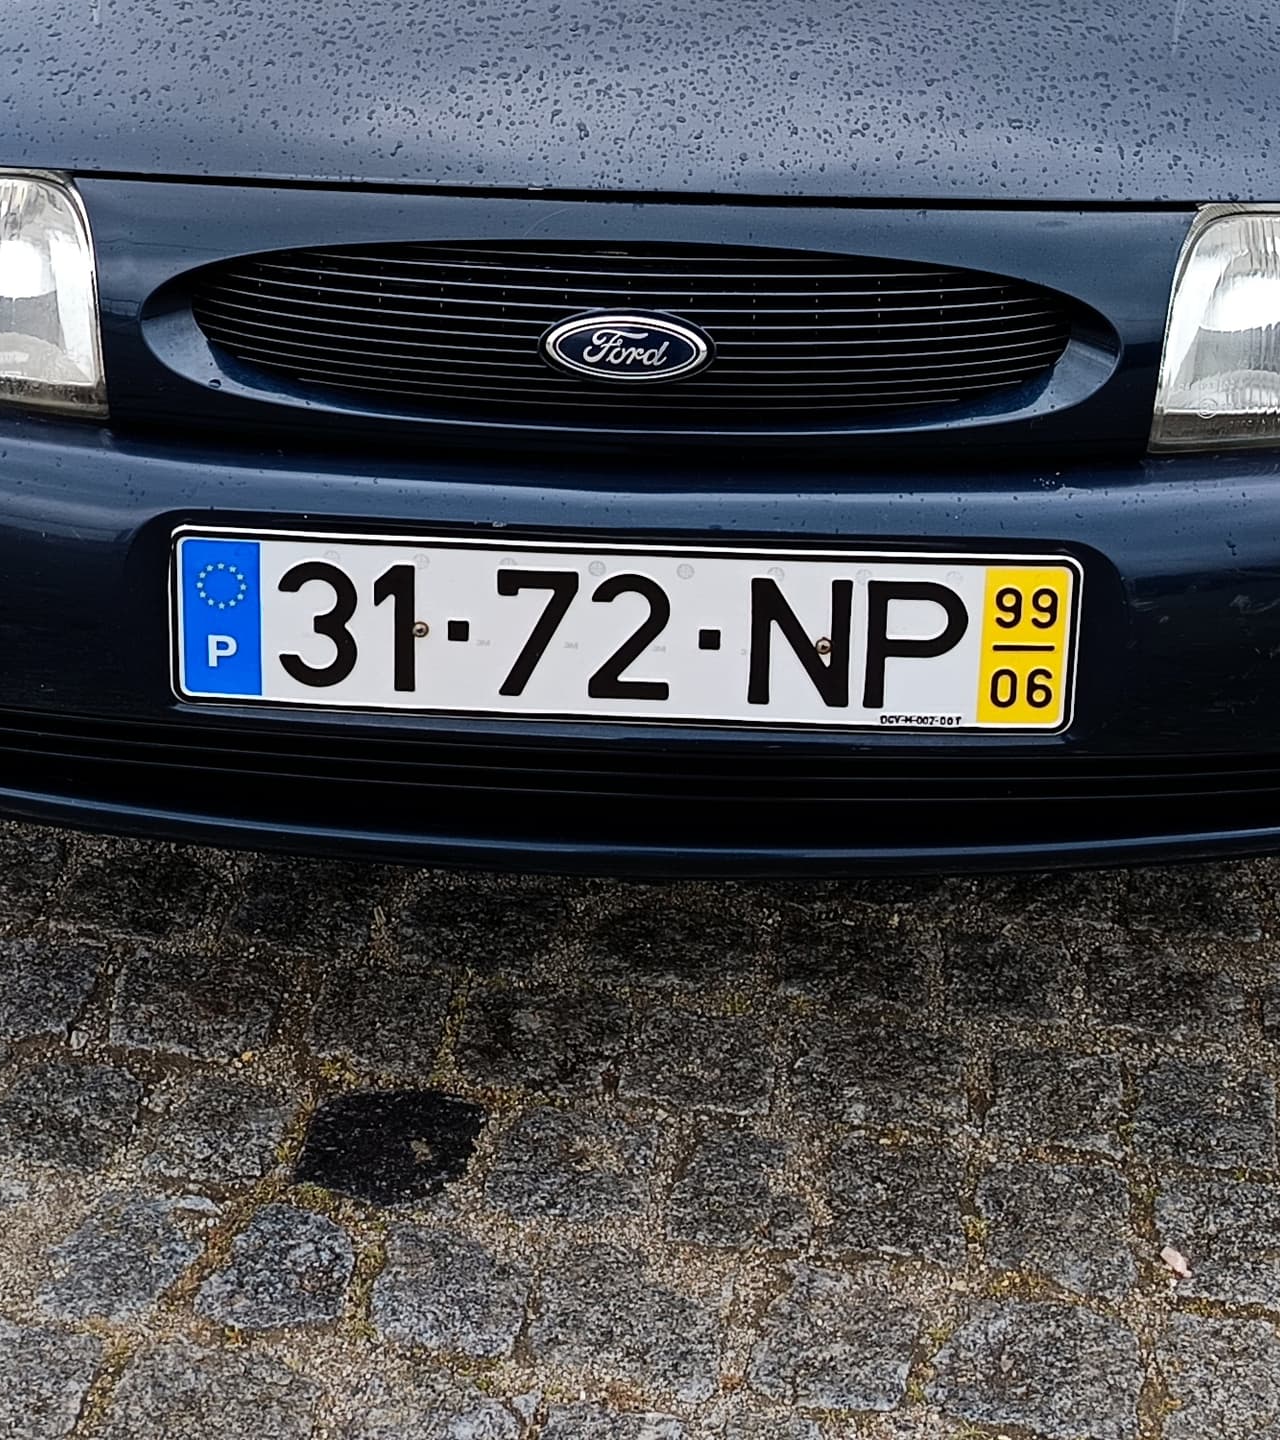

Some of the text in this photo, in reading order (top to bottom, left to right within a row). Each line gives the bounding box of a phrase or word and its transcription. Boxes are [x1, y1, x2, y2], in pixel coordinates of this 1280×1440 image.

[582, 328, 670, 367] Ford
[994, 587, 1059, 630] 99
[207, 633, 238, 667] P
[989, 667, 1054, 709] 06
